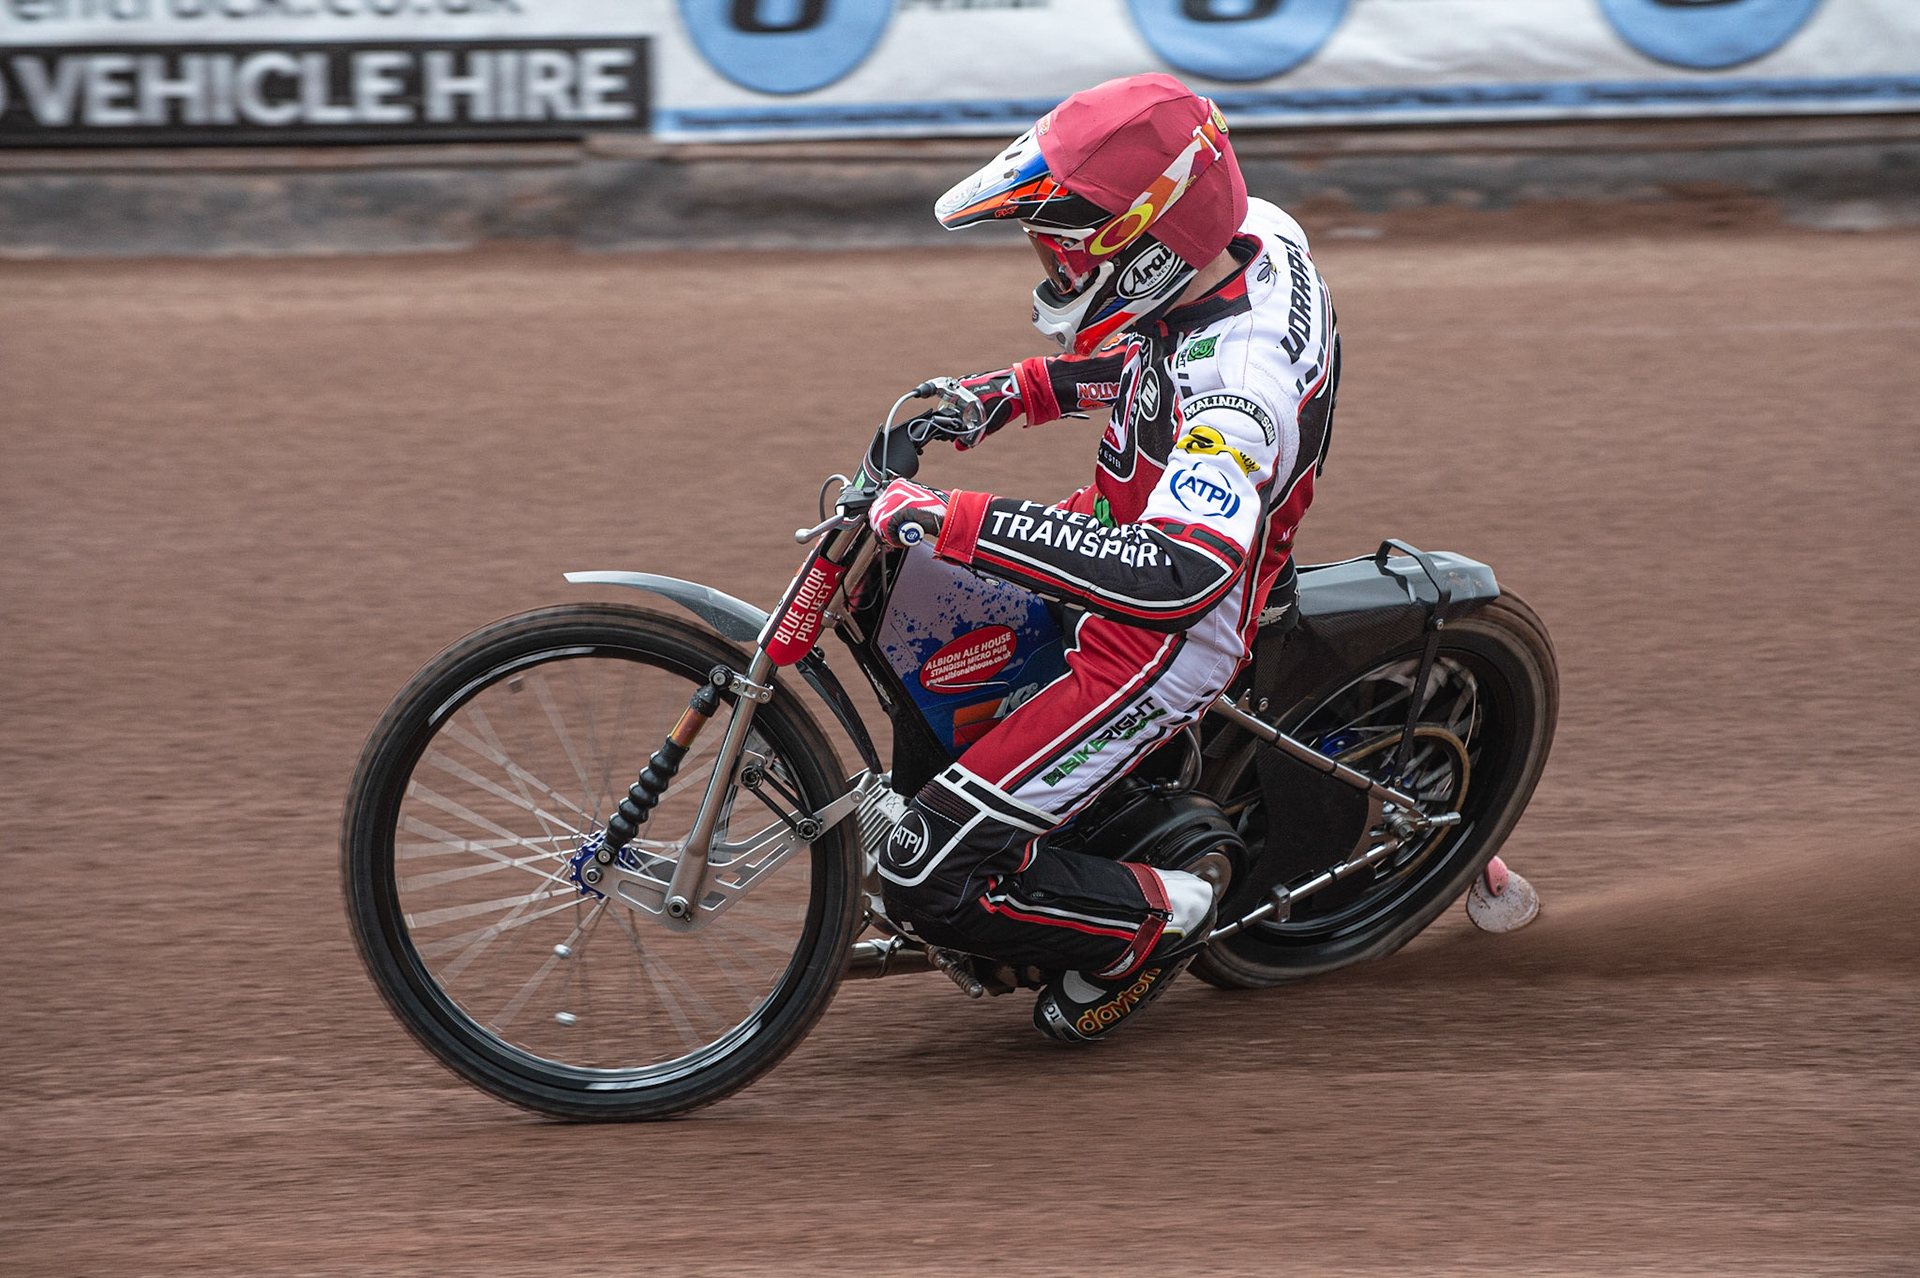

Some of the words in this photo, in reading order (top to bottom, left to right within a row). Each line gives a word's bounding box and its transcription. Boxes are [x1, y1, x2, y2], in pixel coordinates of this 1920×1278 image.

[10, 50, 414, 127] VEHICLE
[424, 48, 638, 121] HIRE
[1128, 244, 1172, 294] Arai
[1177, 475, 1233, 513] ATPI
[773, 606, 805, 646] BLUE
[793, 567, 828, 610] DOOR
[794, 582, 833, 643] PROJECT
[924, 650, 961, 671] ALBION
[962, 643, 980, 659] ALE
[980, 631, 1012, 652] HOUSE
[929, 657, 965, 678] STANDISH
[967, 649, 990, 666] MICRO
[991, 642, 1008, 656] PUB
[1062, 696, 1155, 775] BIKERIGHT
[890, 824, 923, 854] ATPI
[1076, 968, 1162, 1034] dayton
